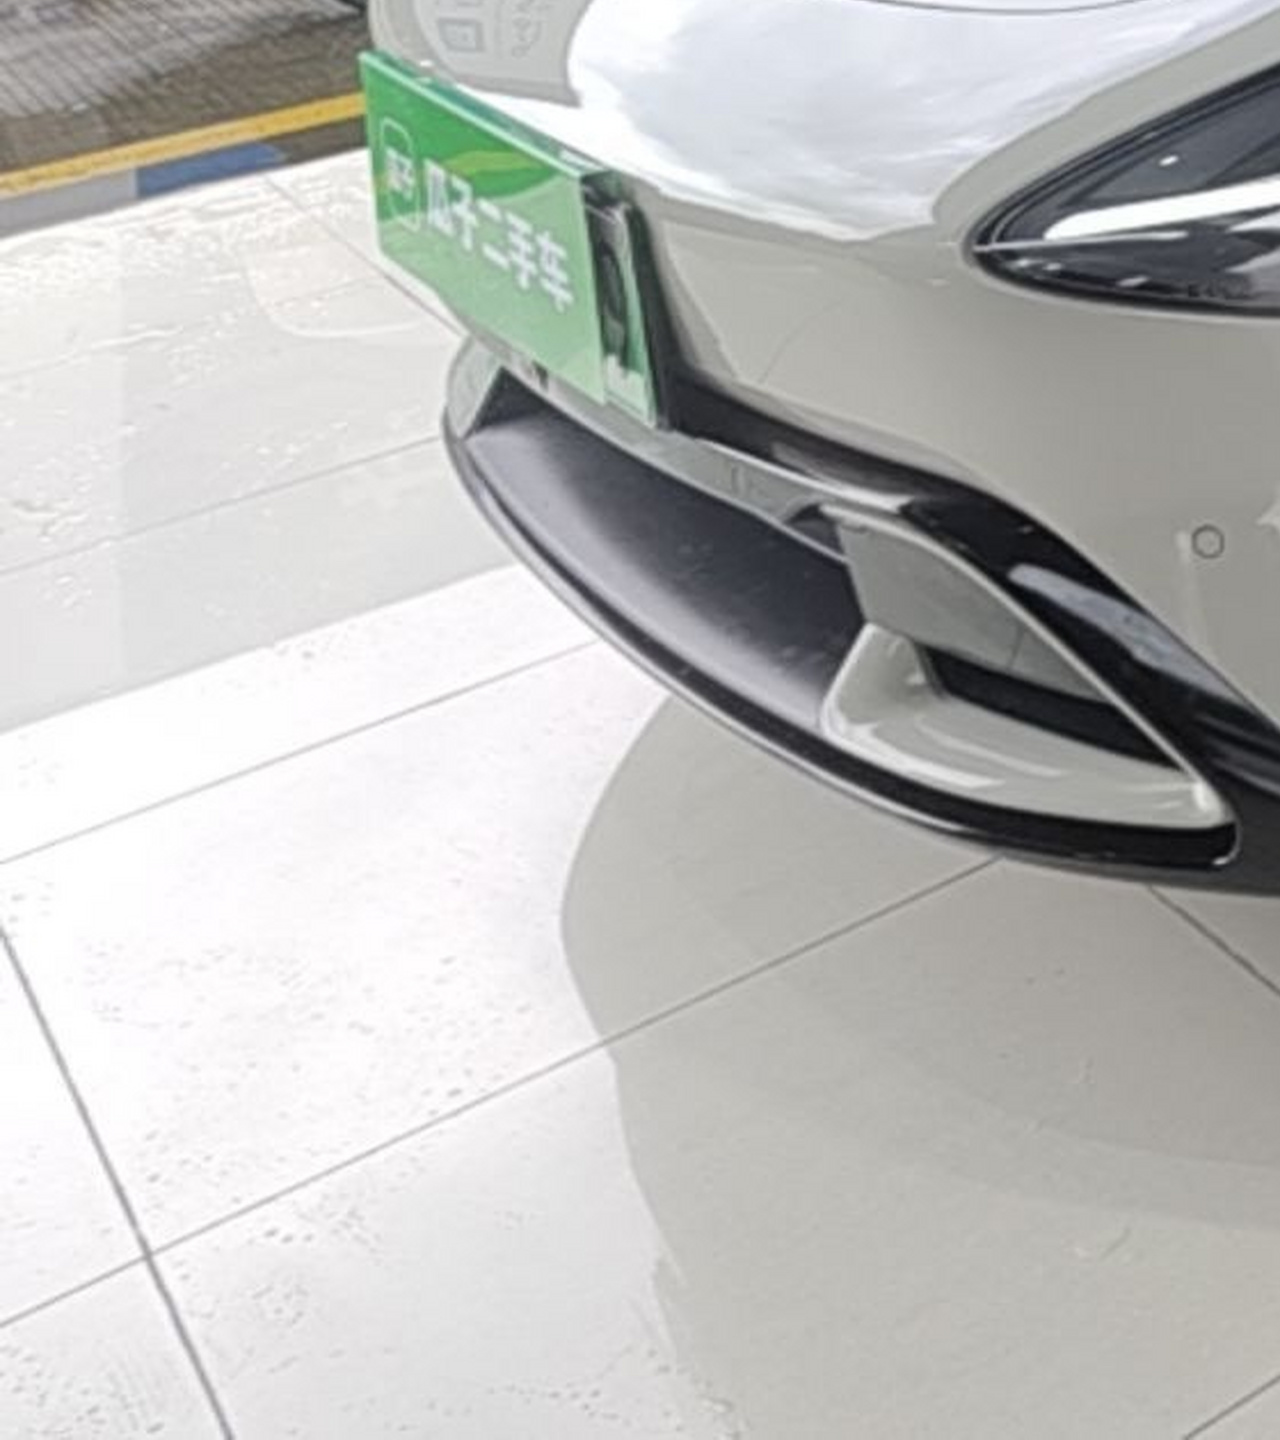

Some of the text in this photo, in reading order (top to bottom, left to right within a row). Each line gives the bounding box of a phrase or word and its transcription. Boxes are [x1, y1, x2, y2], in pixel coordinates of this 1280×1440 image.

[423, 157, 574, 314] 瓜子二手车
